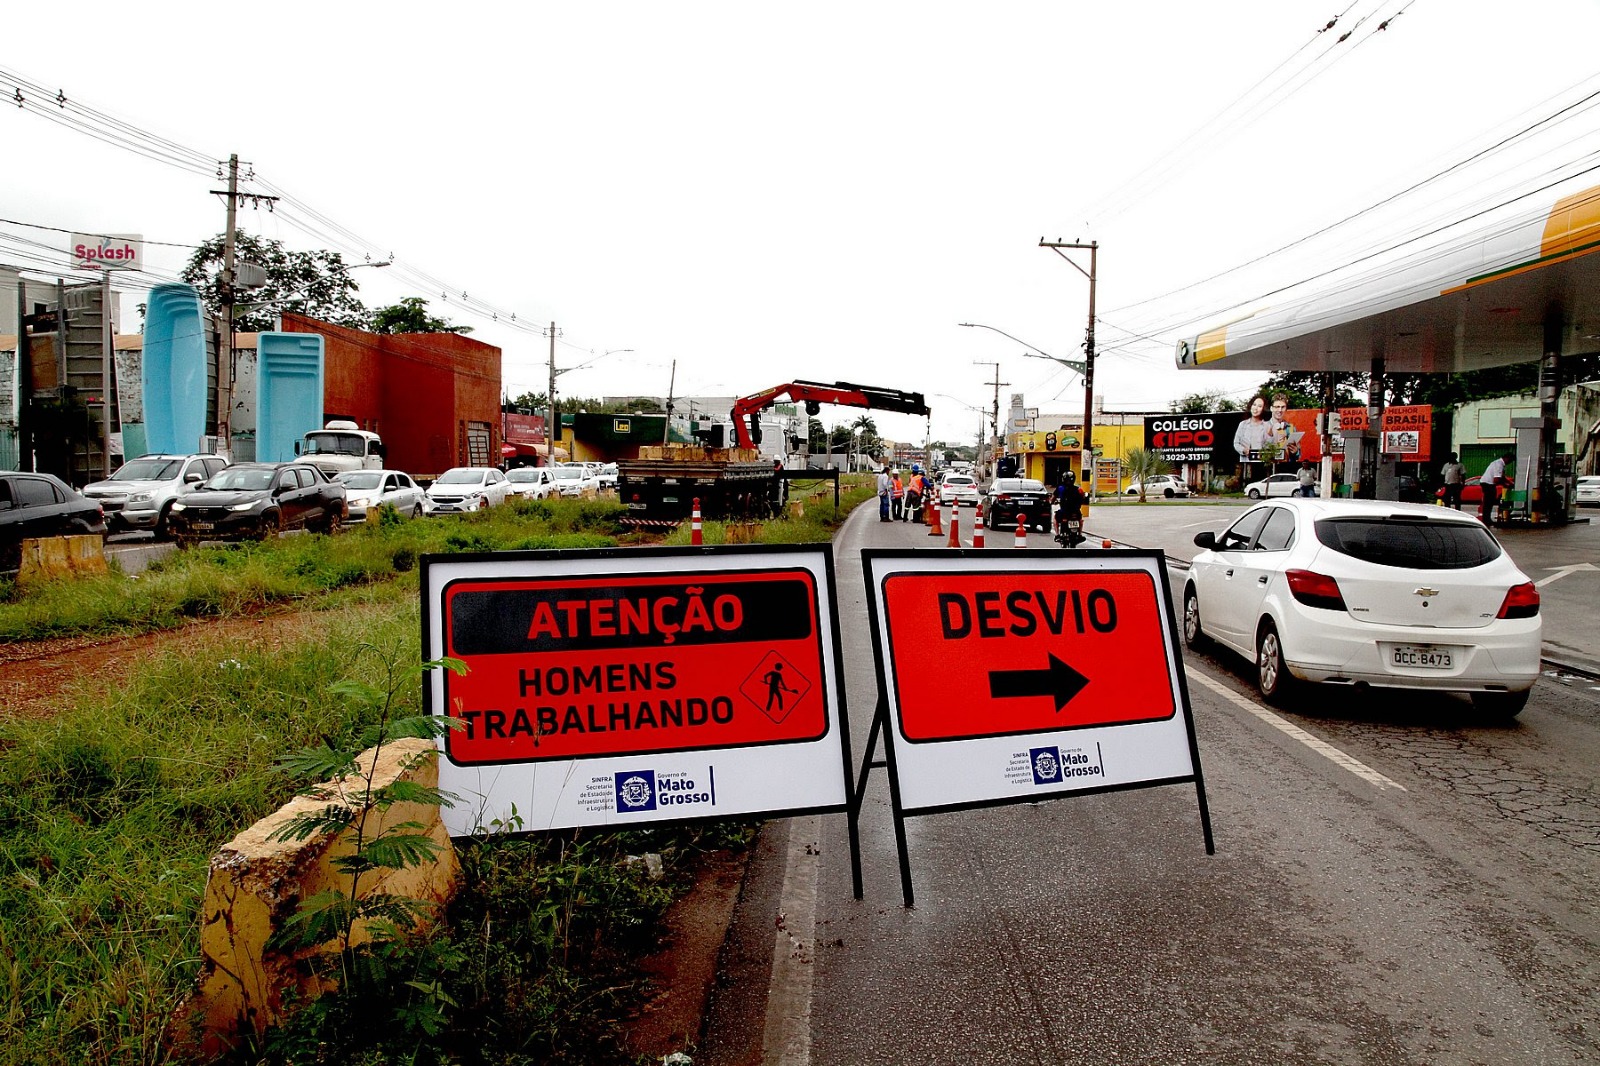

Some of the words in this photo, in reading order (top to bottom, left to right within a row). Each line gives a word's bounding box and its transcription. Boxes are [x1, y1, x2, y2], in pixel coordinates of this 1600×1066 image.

[75, 244, 135, 262] Splash
[1152, 417, 1214, 431] COLÉGIO
[1385, 415, 1429, 425] BRASIL
[527, 586, 744, 644] ATENÇÃO
[938, 588, 1118, 640] DESVIO
[518, 661, 677, 697] HOMENS
[462, 696, 734, 742] TRABALHANDO
[1061, 754, 1088, 765] Mato
[1064, 766, 1100, 777] Grosso
[586, 783, 613, 791] Secretaria
[658, 778, 695, 792] Mato
[659, 792, 710, 805] Grosso
